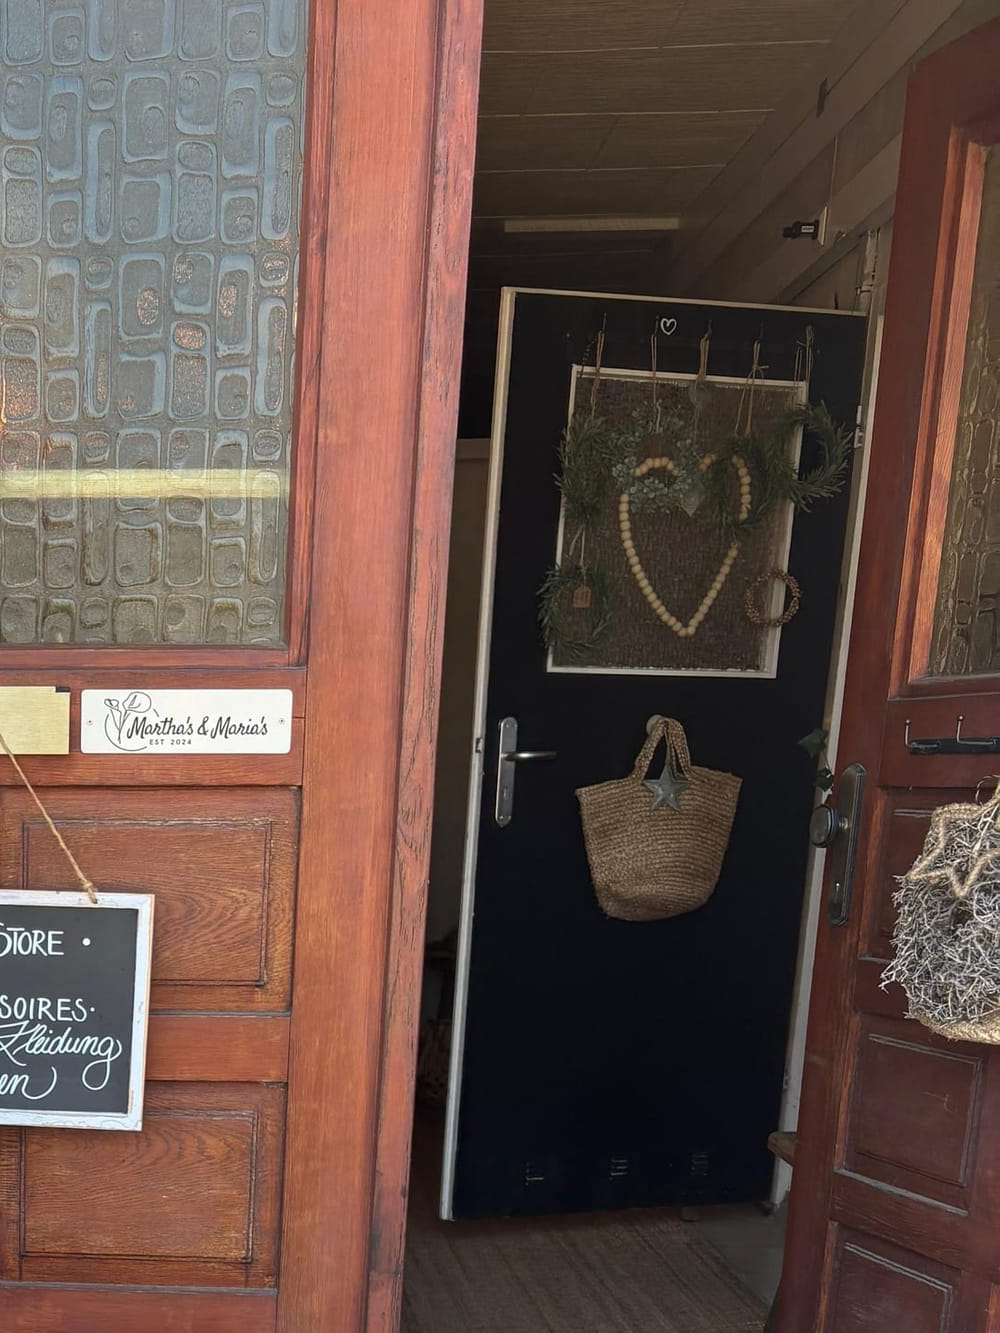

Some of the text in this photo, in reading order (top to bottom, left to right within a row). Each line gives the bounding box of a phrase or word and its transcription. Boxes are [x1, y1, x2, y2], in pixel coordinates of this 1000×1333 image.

[126, 716, 268, 740] Martha's & Maria's
[149, 738, 193, 746] EST 2024
